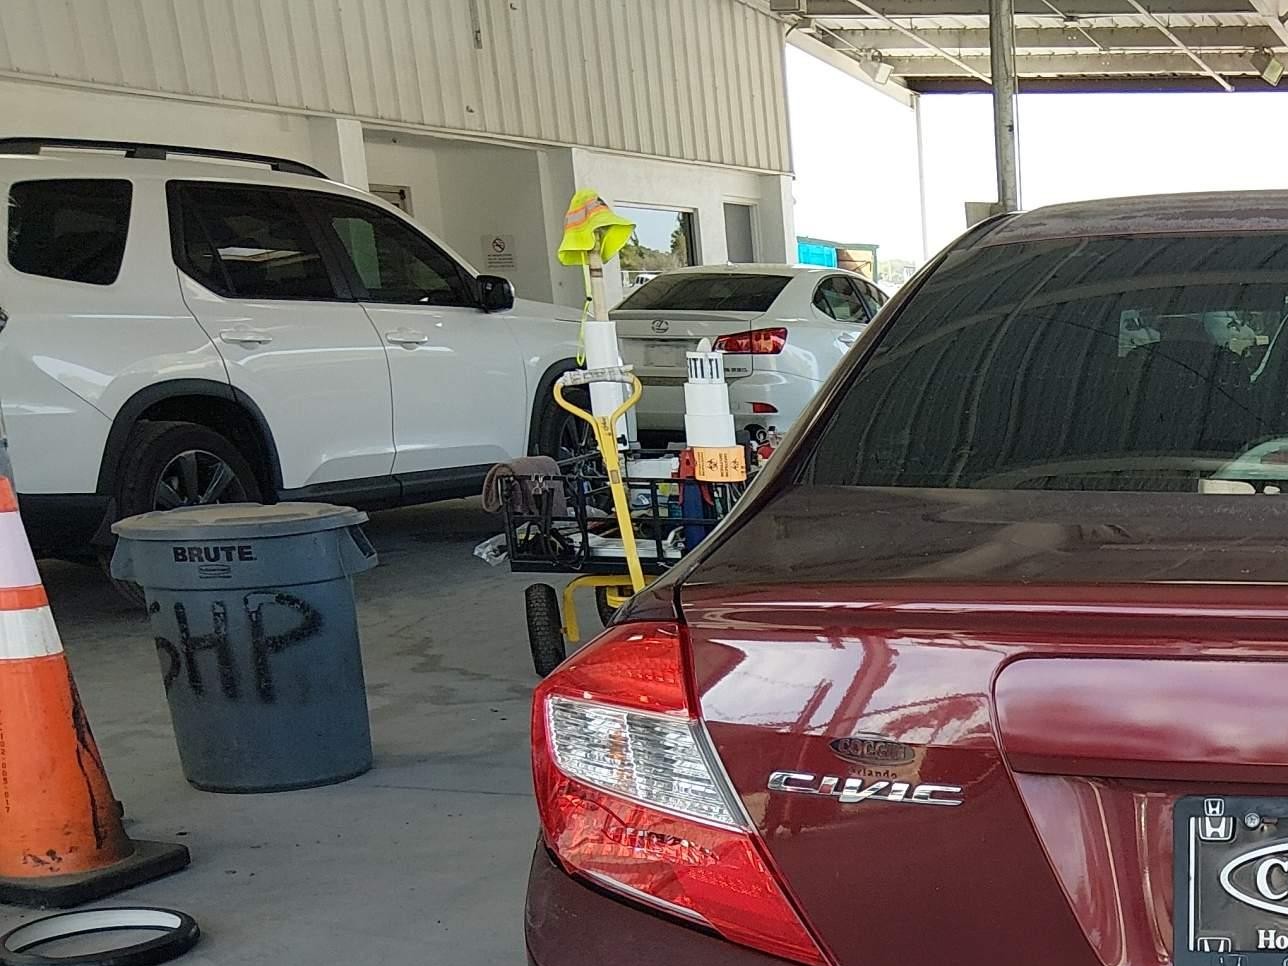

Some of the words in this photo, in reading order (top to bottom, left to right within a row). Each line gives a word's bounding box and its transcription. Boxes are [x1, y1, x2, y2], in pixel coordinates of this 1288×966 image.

[173, 545, 254, 562] BRUTE
[838, 738, 907, 760] COGGIN
[768, 770, 965, 807] CIVIC
